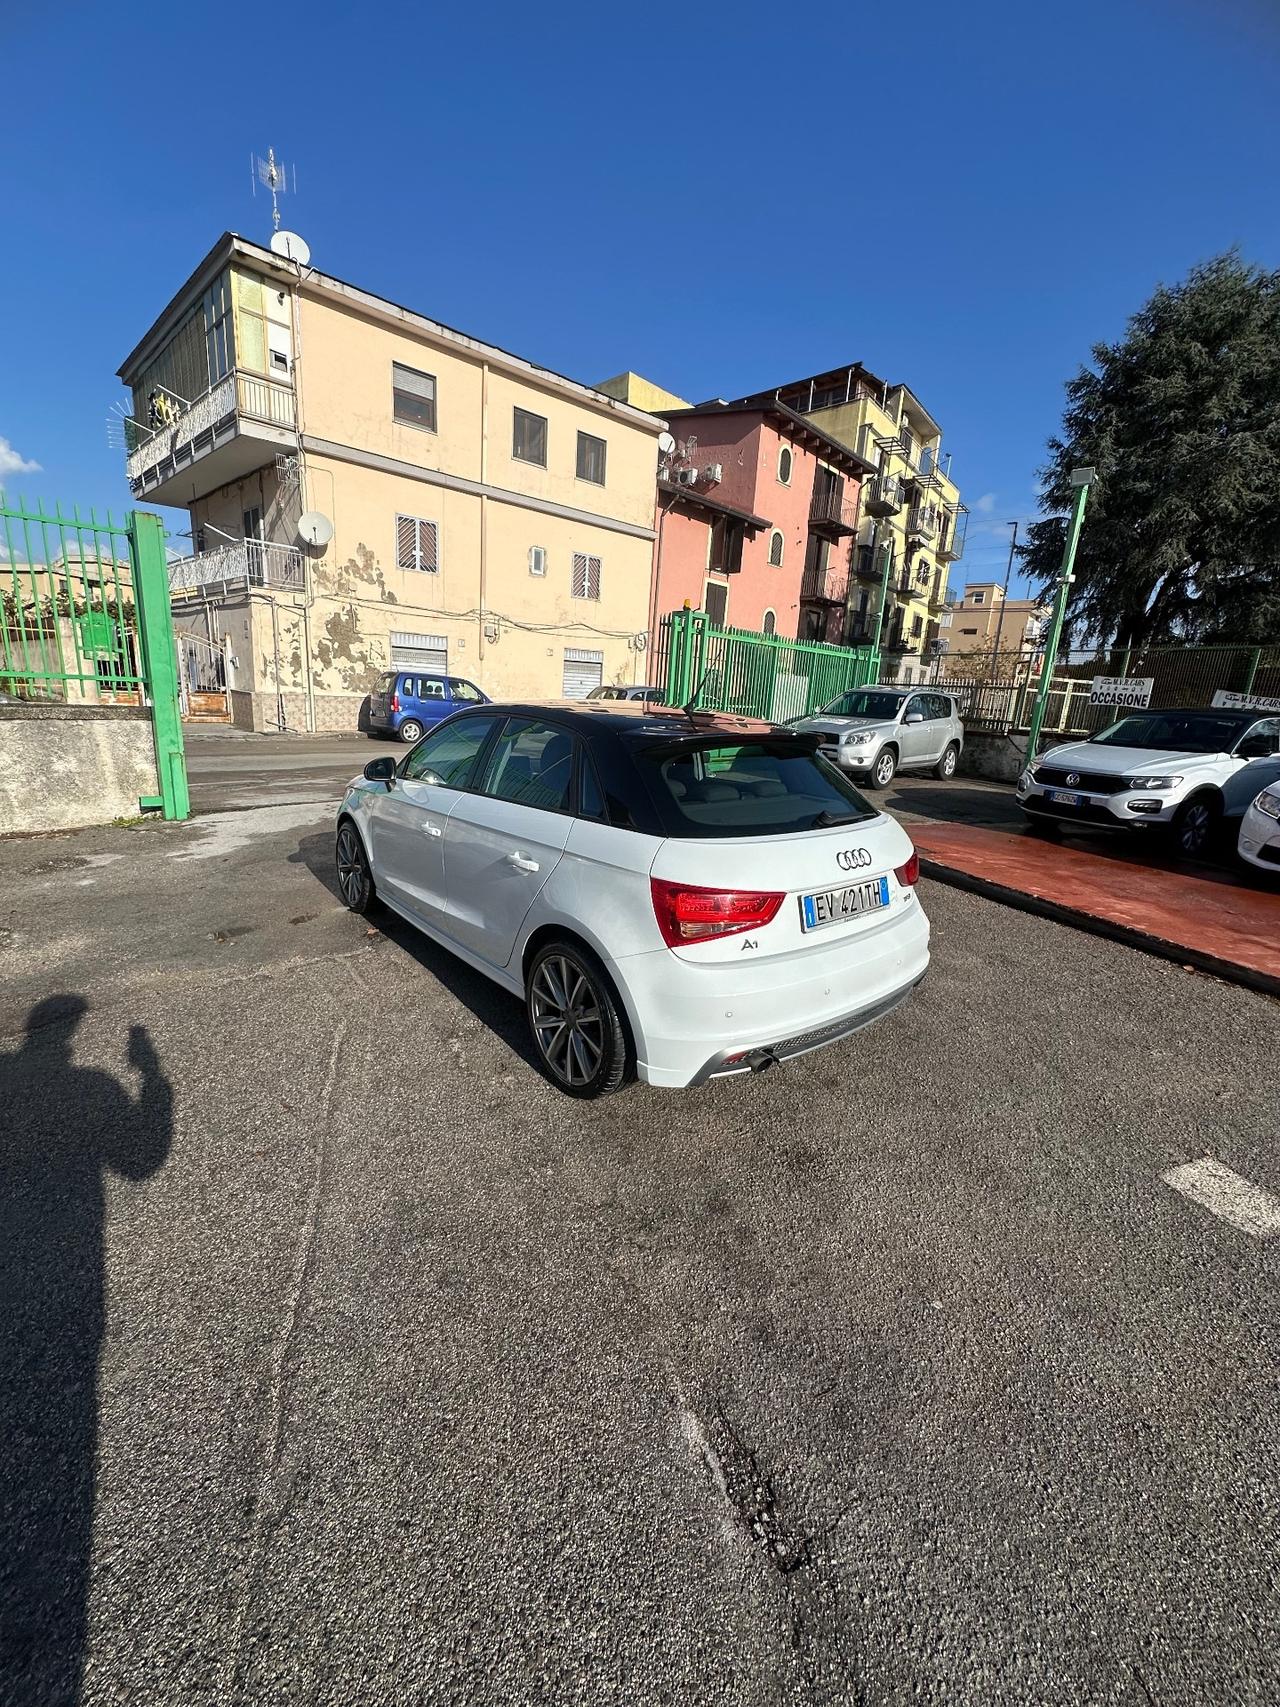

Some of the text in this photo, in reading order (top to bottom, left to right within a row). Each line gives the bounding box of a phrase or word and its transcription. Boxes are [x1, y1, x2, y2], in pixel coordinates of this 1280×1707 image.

[1090, 691, 1149, 707] OCCASIONE
[816, 893, 834, 920] EV
[841, 881, 880, 914] 421TH
[740, 938, 758, 951] A1
